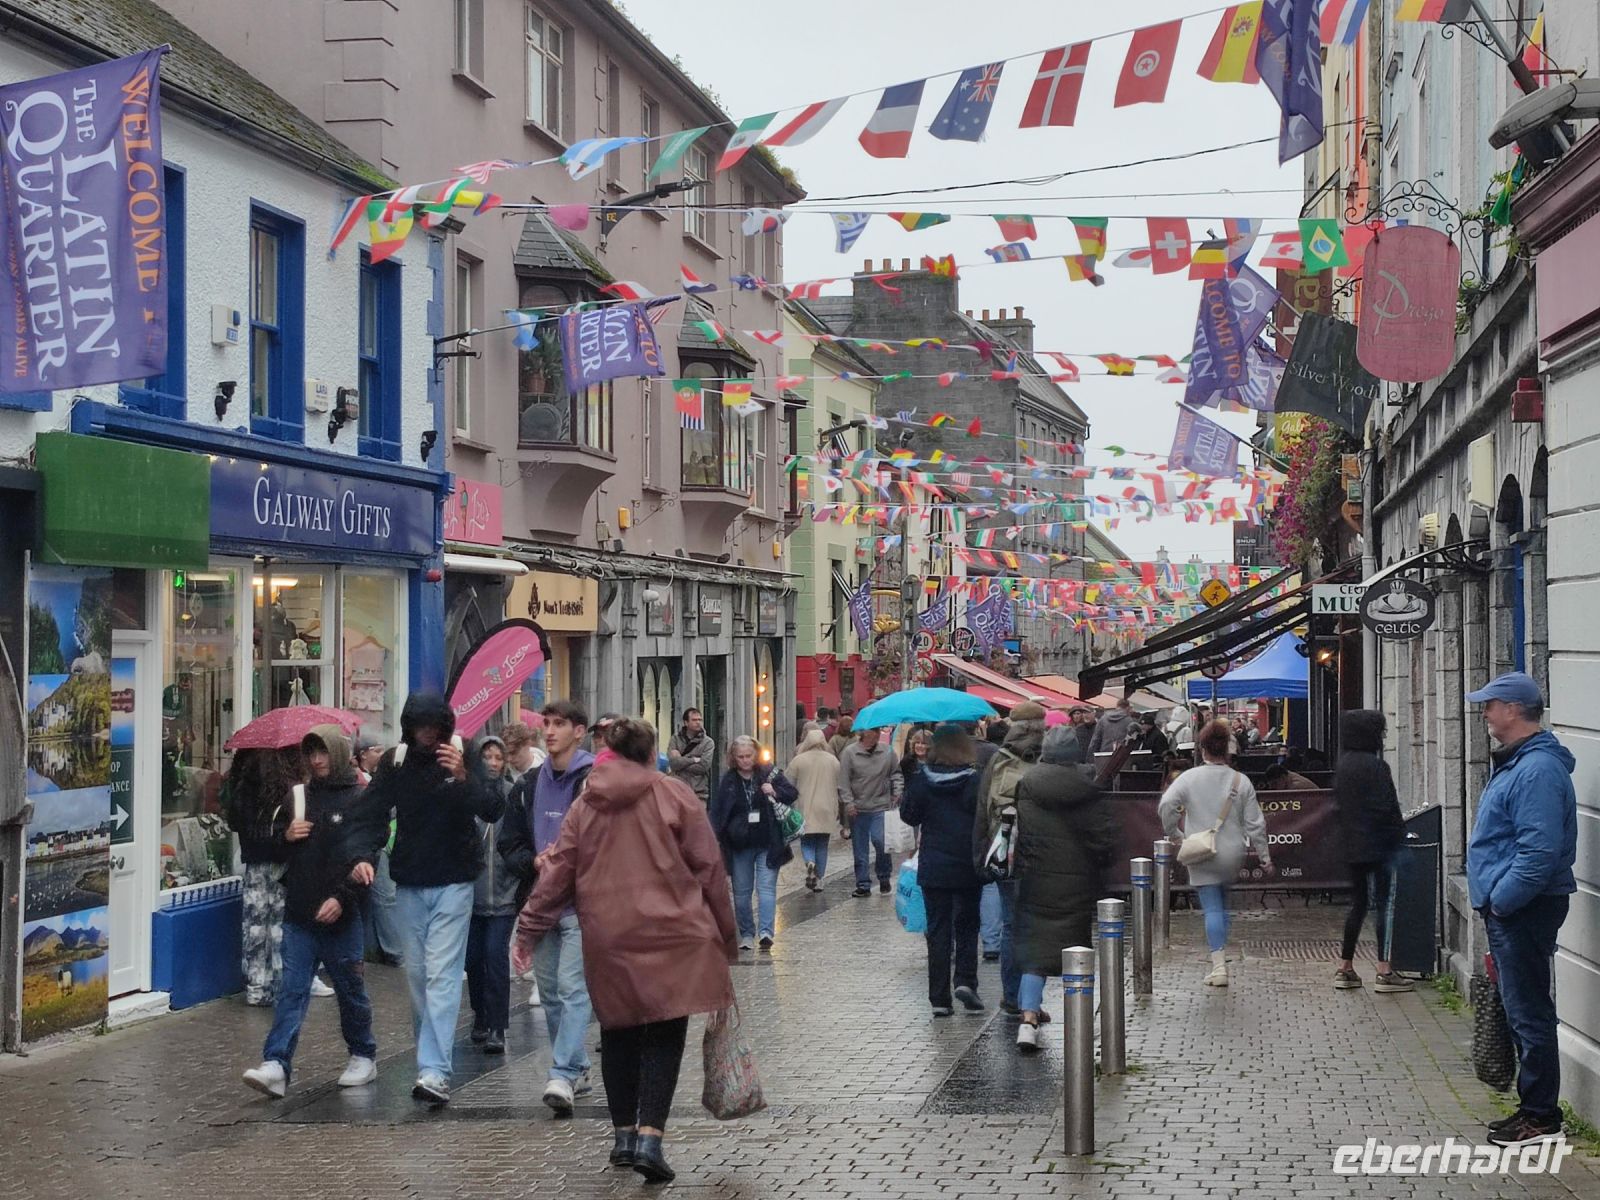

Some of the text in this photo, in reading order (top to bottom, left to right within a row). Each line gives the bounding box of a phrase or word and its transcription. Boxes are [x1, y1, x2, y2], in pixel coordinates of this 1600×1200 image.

[73, 79, 97, 143] THE
[121, 66, 161, 292] WELCOME
[6, 90, 69, 382] QUARTER
[60, 139, 121, 358] LATIN
[15, 336, 29, 377] ALIVE
[1223, 354, 1241, 379] TO
[253, 476, 335, 532] GALWAY
[341, 489, 391, 538] GIFTS
[110, 761, 120, 773] OP
[111, 780, 130, 793] ANCE
[1260, 800, 1302, 812] LOY'S
